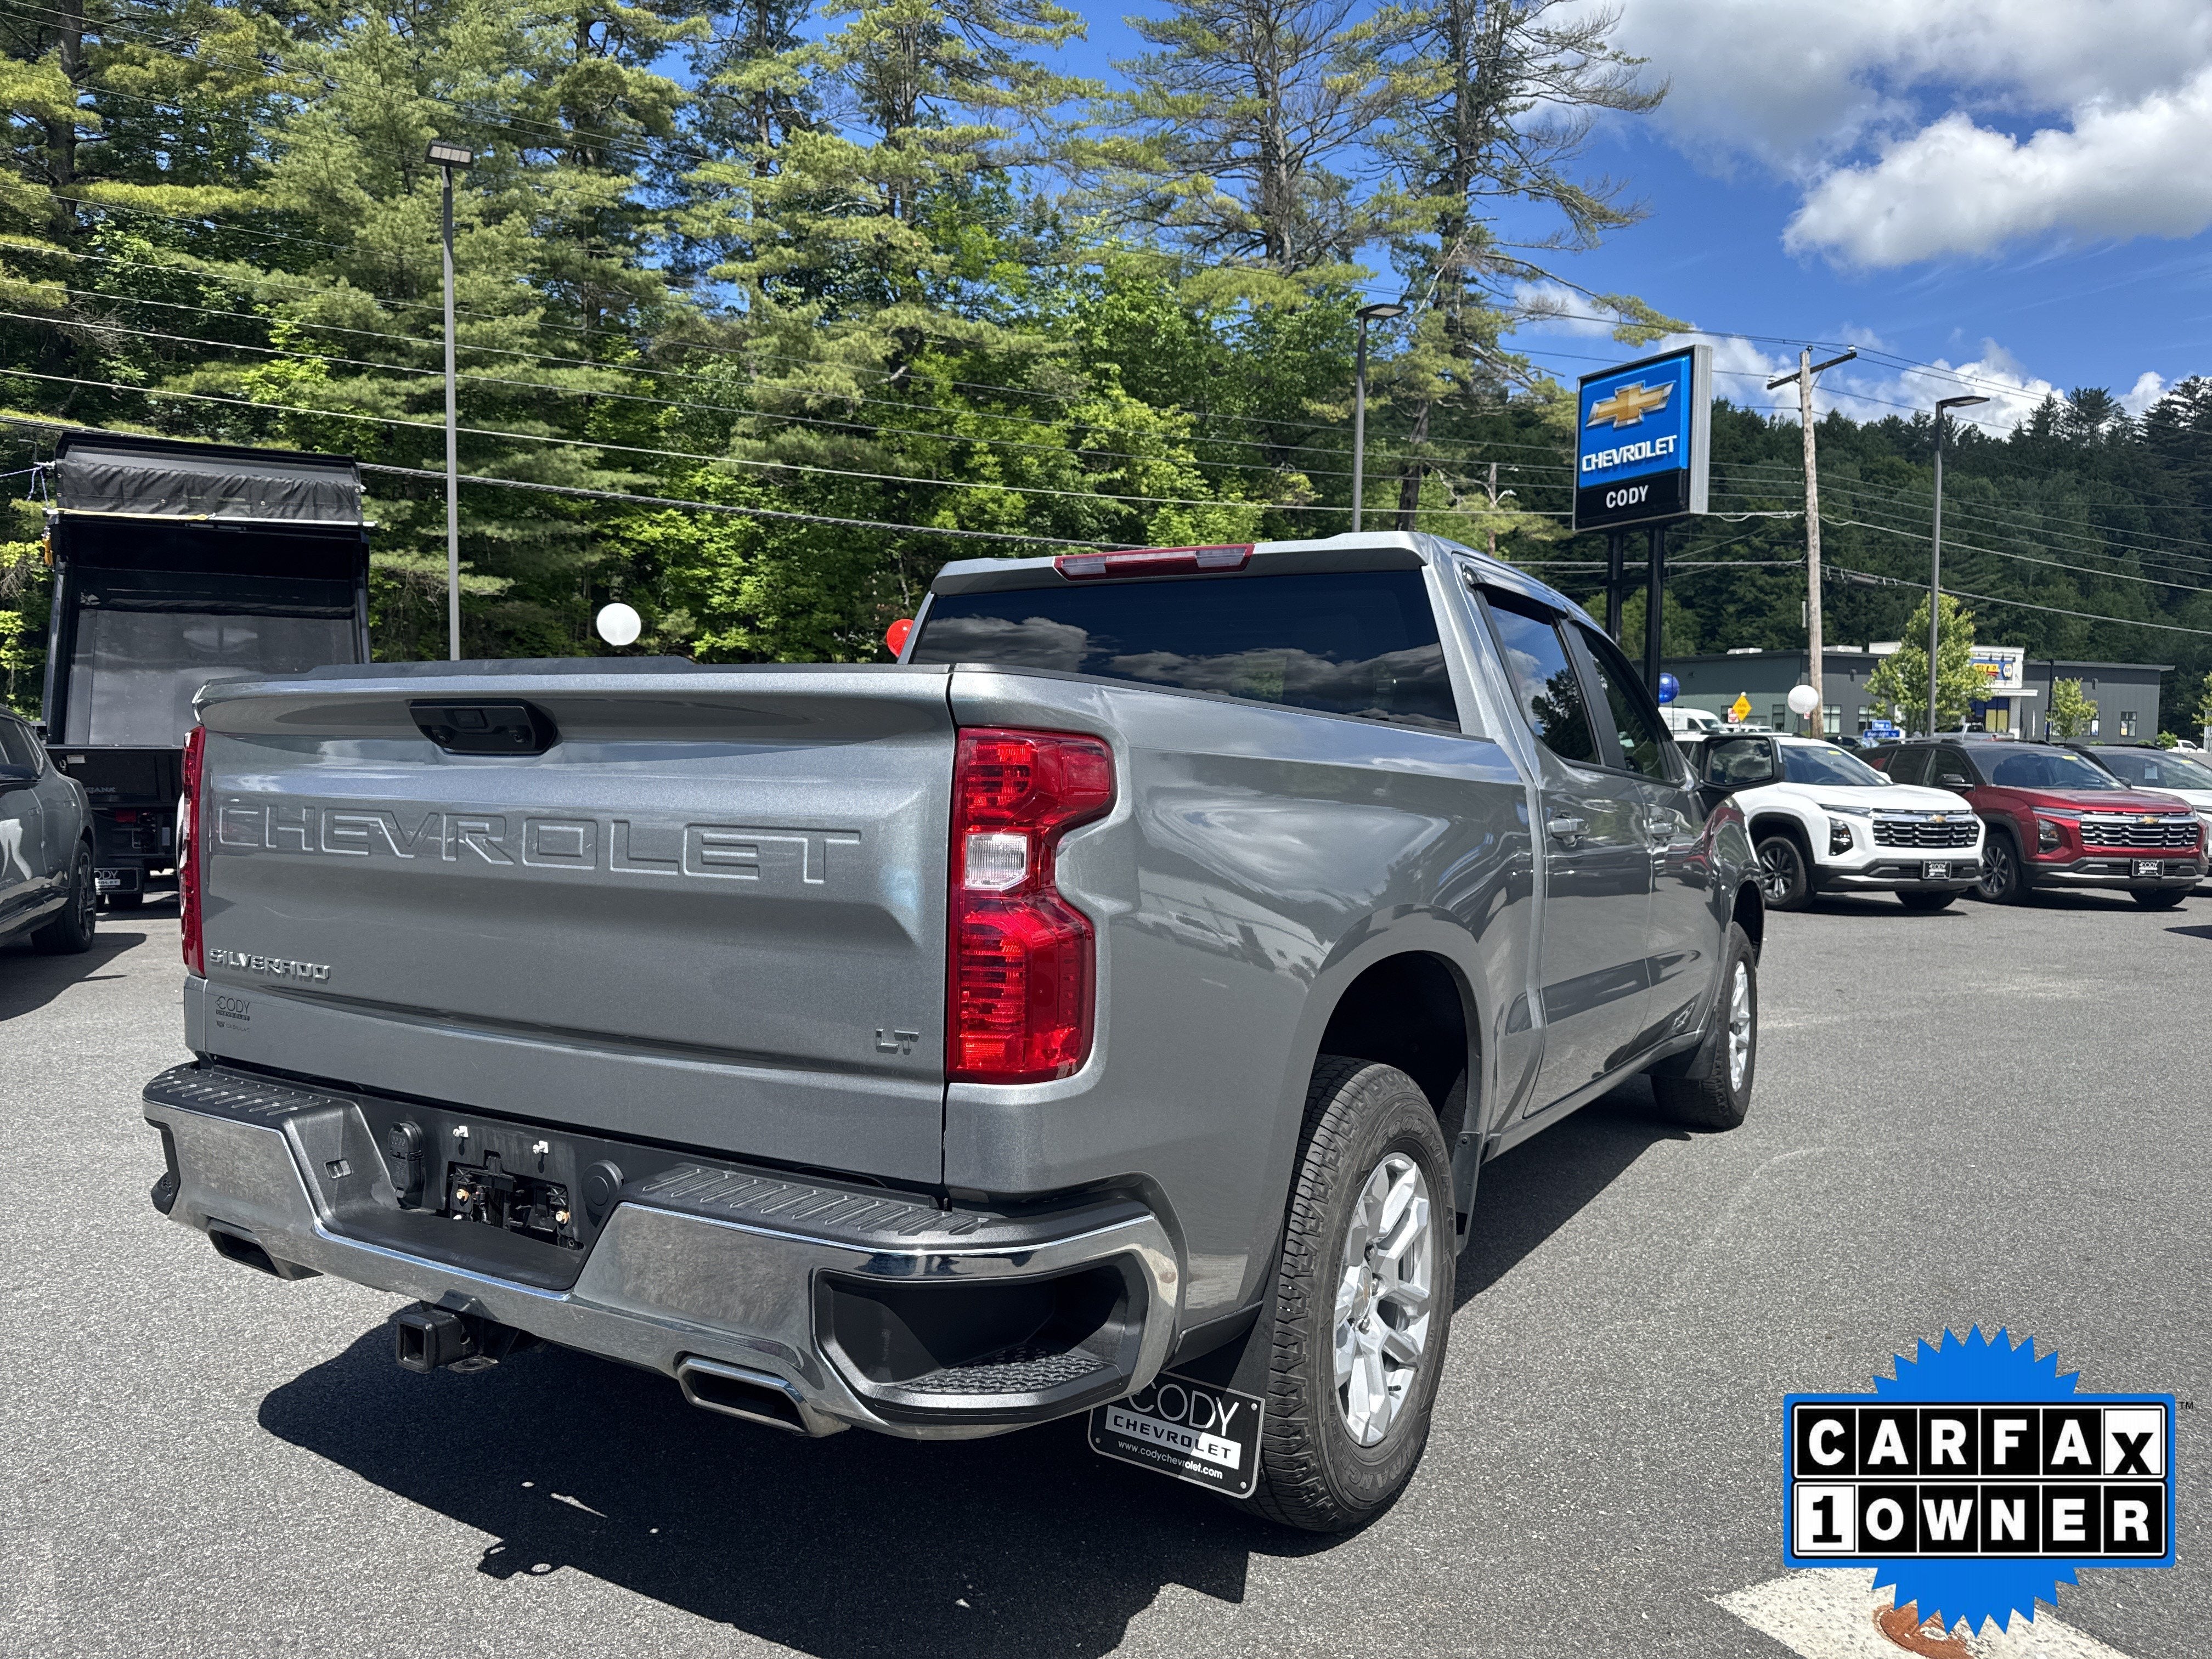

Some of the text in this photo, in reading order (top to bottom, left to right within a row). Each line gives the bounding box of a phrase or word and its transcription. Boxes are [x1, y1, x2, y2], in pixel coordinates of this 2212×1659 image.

[1582, 435, 1677, 472] CHEVROLET
[1606, 485, 1649, 508] CODY
[218, 805, 861, 884] CHEVROLET
[210, 949, 330, 979] SILVERADO
[215, 996, 250, 1014] CODY
[876, 1028, 919, 1051] LT
[1113, 1415, 1232, 1459] CHEVROLET
[1118, 1440, 1223, 1480] www.codychevrolet.com
